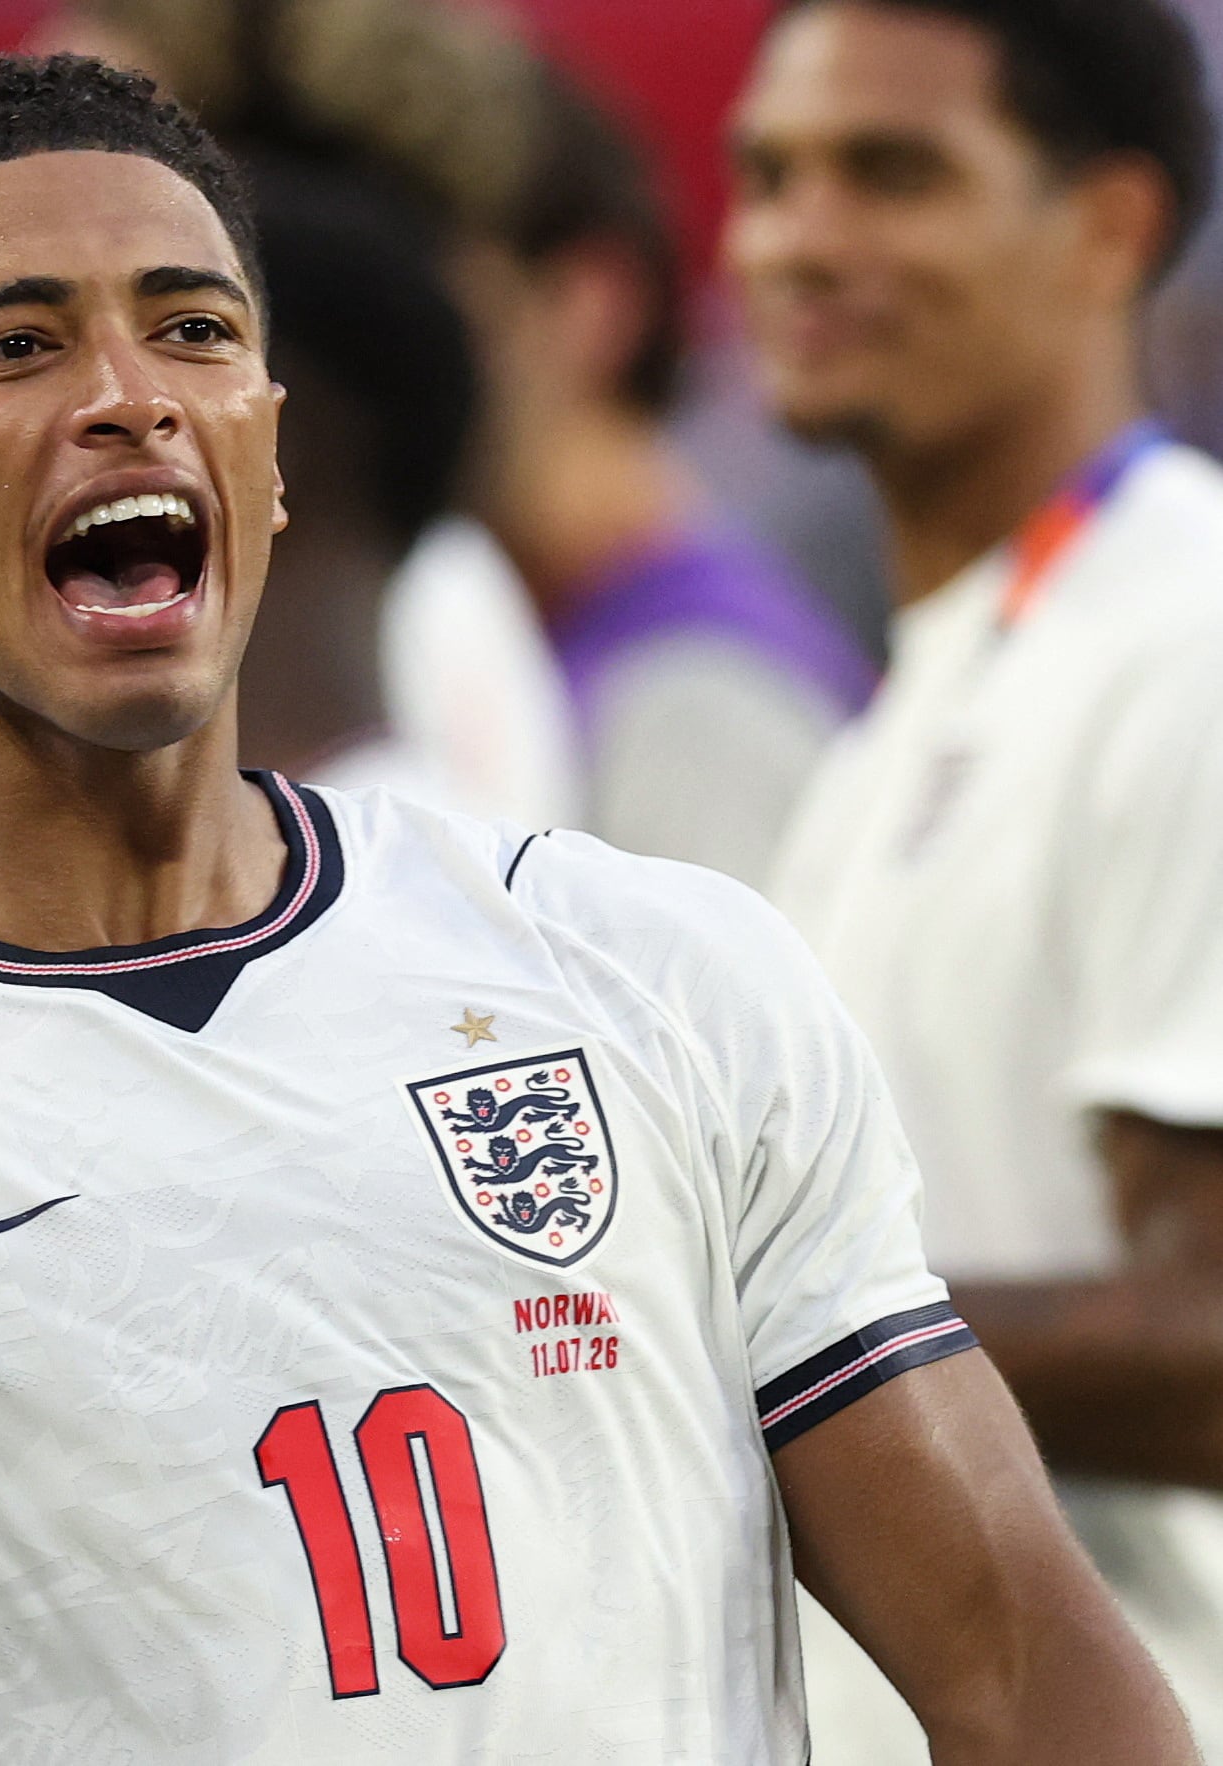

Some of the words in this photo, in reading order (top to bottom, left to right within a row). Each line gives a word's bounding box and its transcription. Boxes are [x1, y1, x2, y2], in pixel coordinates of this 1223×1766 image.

[513, 1292, 620, 1333] NORWA
[531, 1336, 619, 1378] 11.07.26
[252, 1382, 507, 1700] 10
